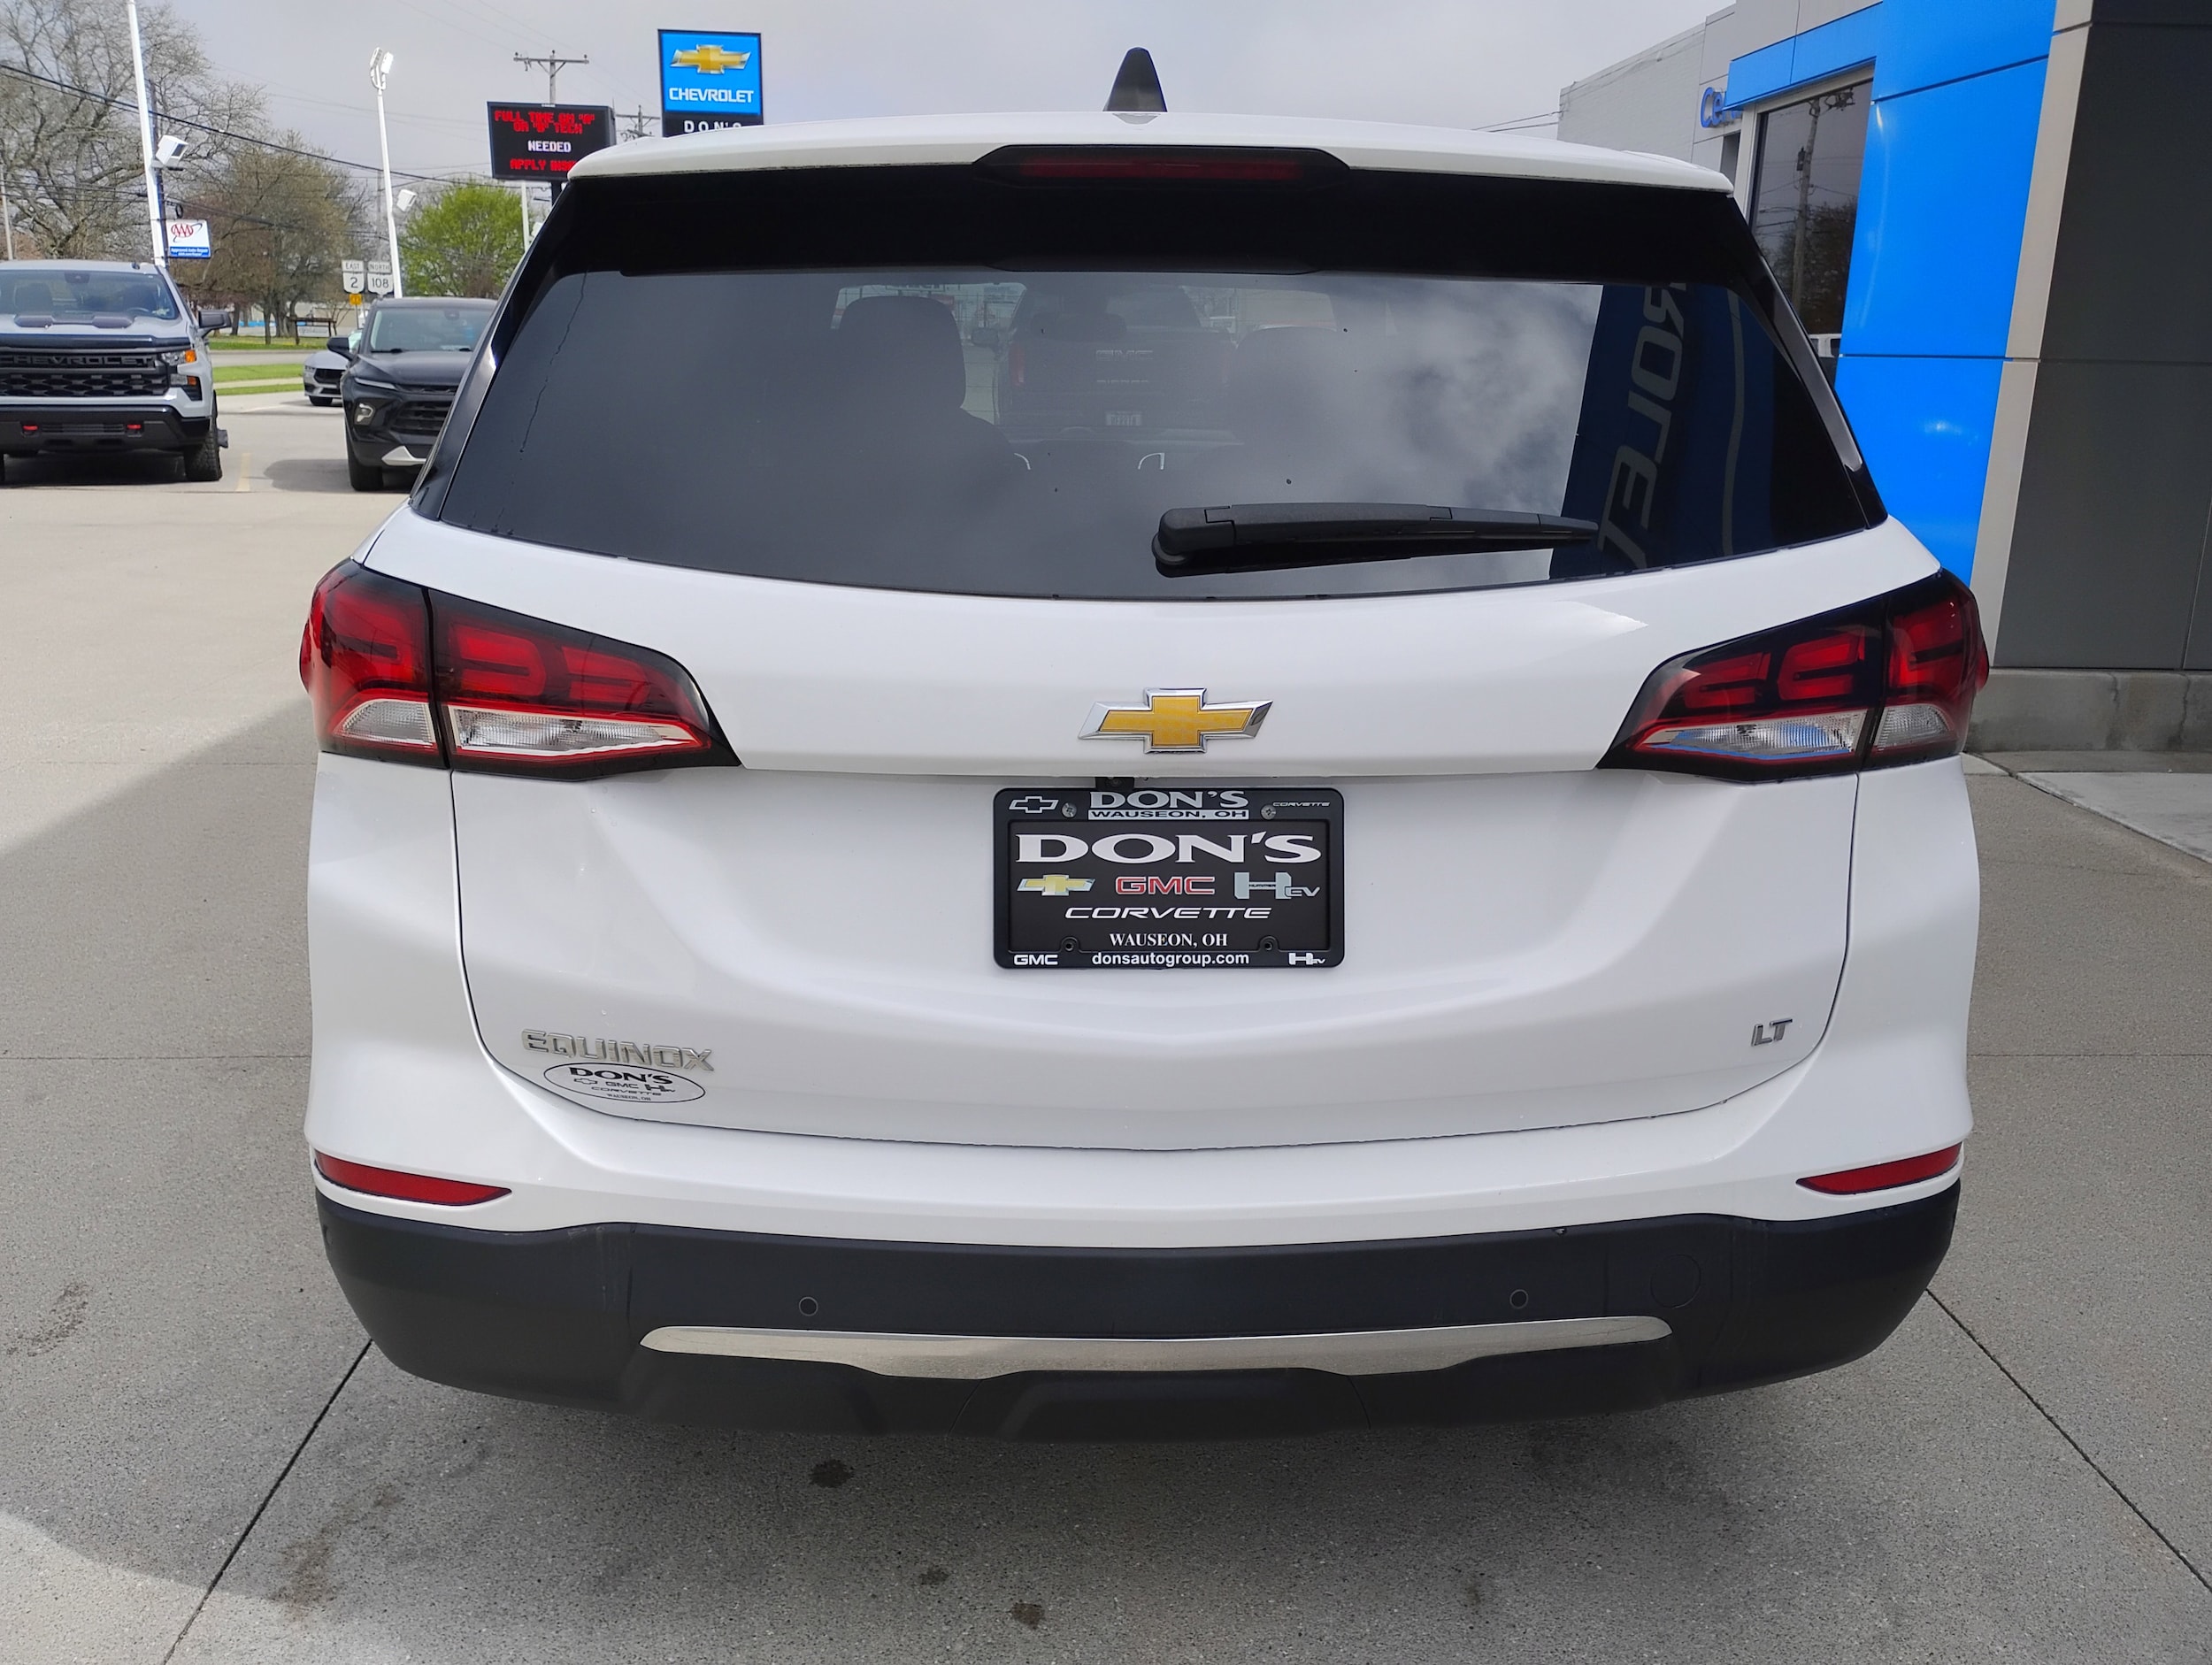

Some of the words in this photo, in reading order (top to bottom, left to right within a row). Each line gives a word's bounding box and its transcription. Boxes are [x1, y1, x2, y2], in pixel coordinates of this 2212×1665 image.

[669, 87, 754, 103] CHEVROLET
[527, 141, 572, 153] NEEDED
[510, 158, 546, 171] APPLY
[349, 276, 359, 289] 2
[372, 278, 389, 289] 108
[1089, 790, 1248, 809] DON'S
[1091, 809, 1207, 819] WAUSEON,
[1214, 809, 1247, 818] OH
[1015, 831, 1322, 863] DON'S
[1114, 876, 1216, 895] GMC
[1064, 906, 1272, 919] CORVETTE
[1109, 932, 1198, 949] WAUSEON,
[1202, 932, 1228, 948] OH
[1013, 954, 1059, 966] GMC
[1091, 951, 1249, 968] donsautogroup.com
[1751, 1018, 1793, 1047] LT
[521, 1029, 715, 1072] EQUINOX
[568, 1067, 673, 1085] DON'S
[591, 1086, 662, 1096] CORVETTE
[605, 1081, 640, 1090] GMC
